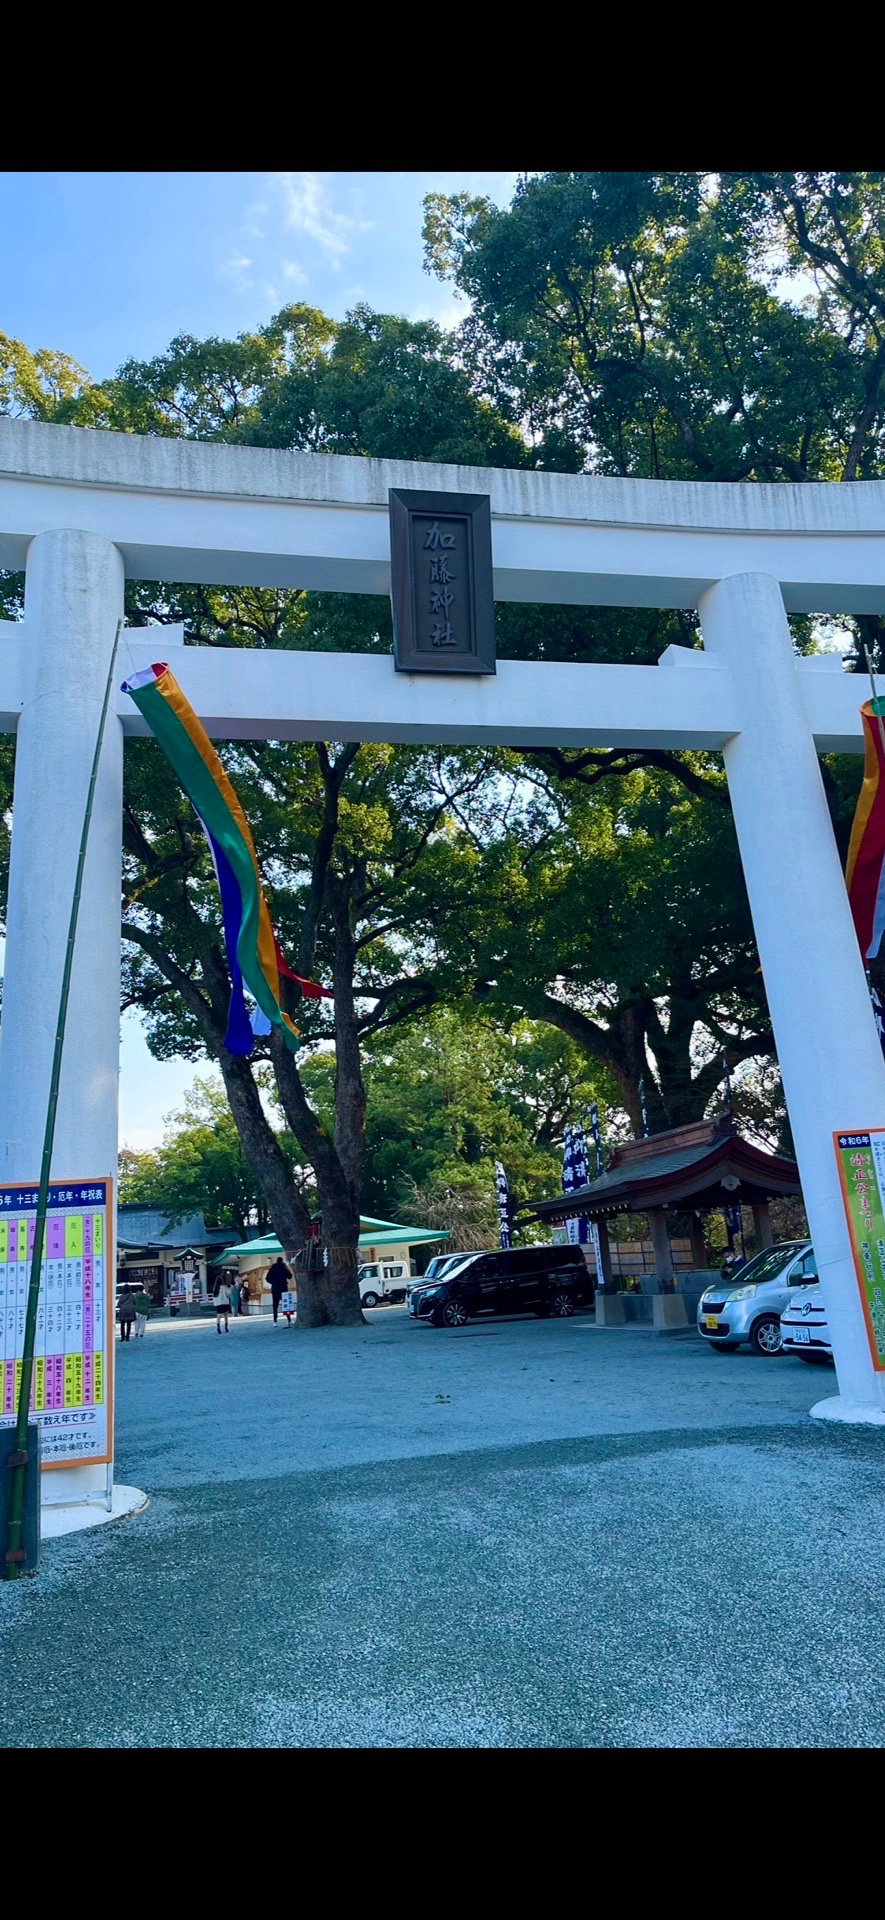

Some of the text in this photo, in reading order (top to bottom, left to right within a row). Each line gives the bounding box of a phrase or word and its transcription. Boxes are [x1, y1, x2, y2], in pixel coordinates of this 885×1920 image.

[423, 520, 458, 647] 加藤神社
[839, 1136, 870, 1146] 令和6年
[849, 1152, 874, 1232] 清正公まつり
